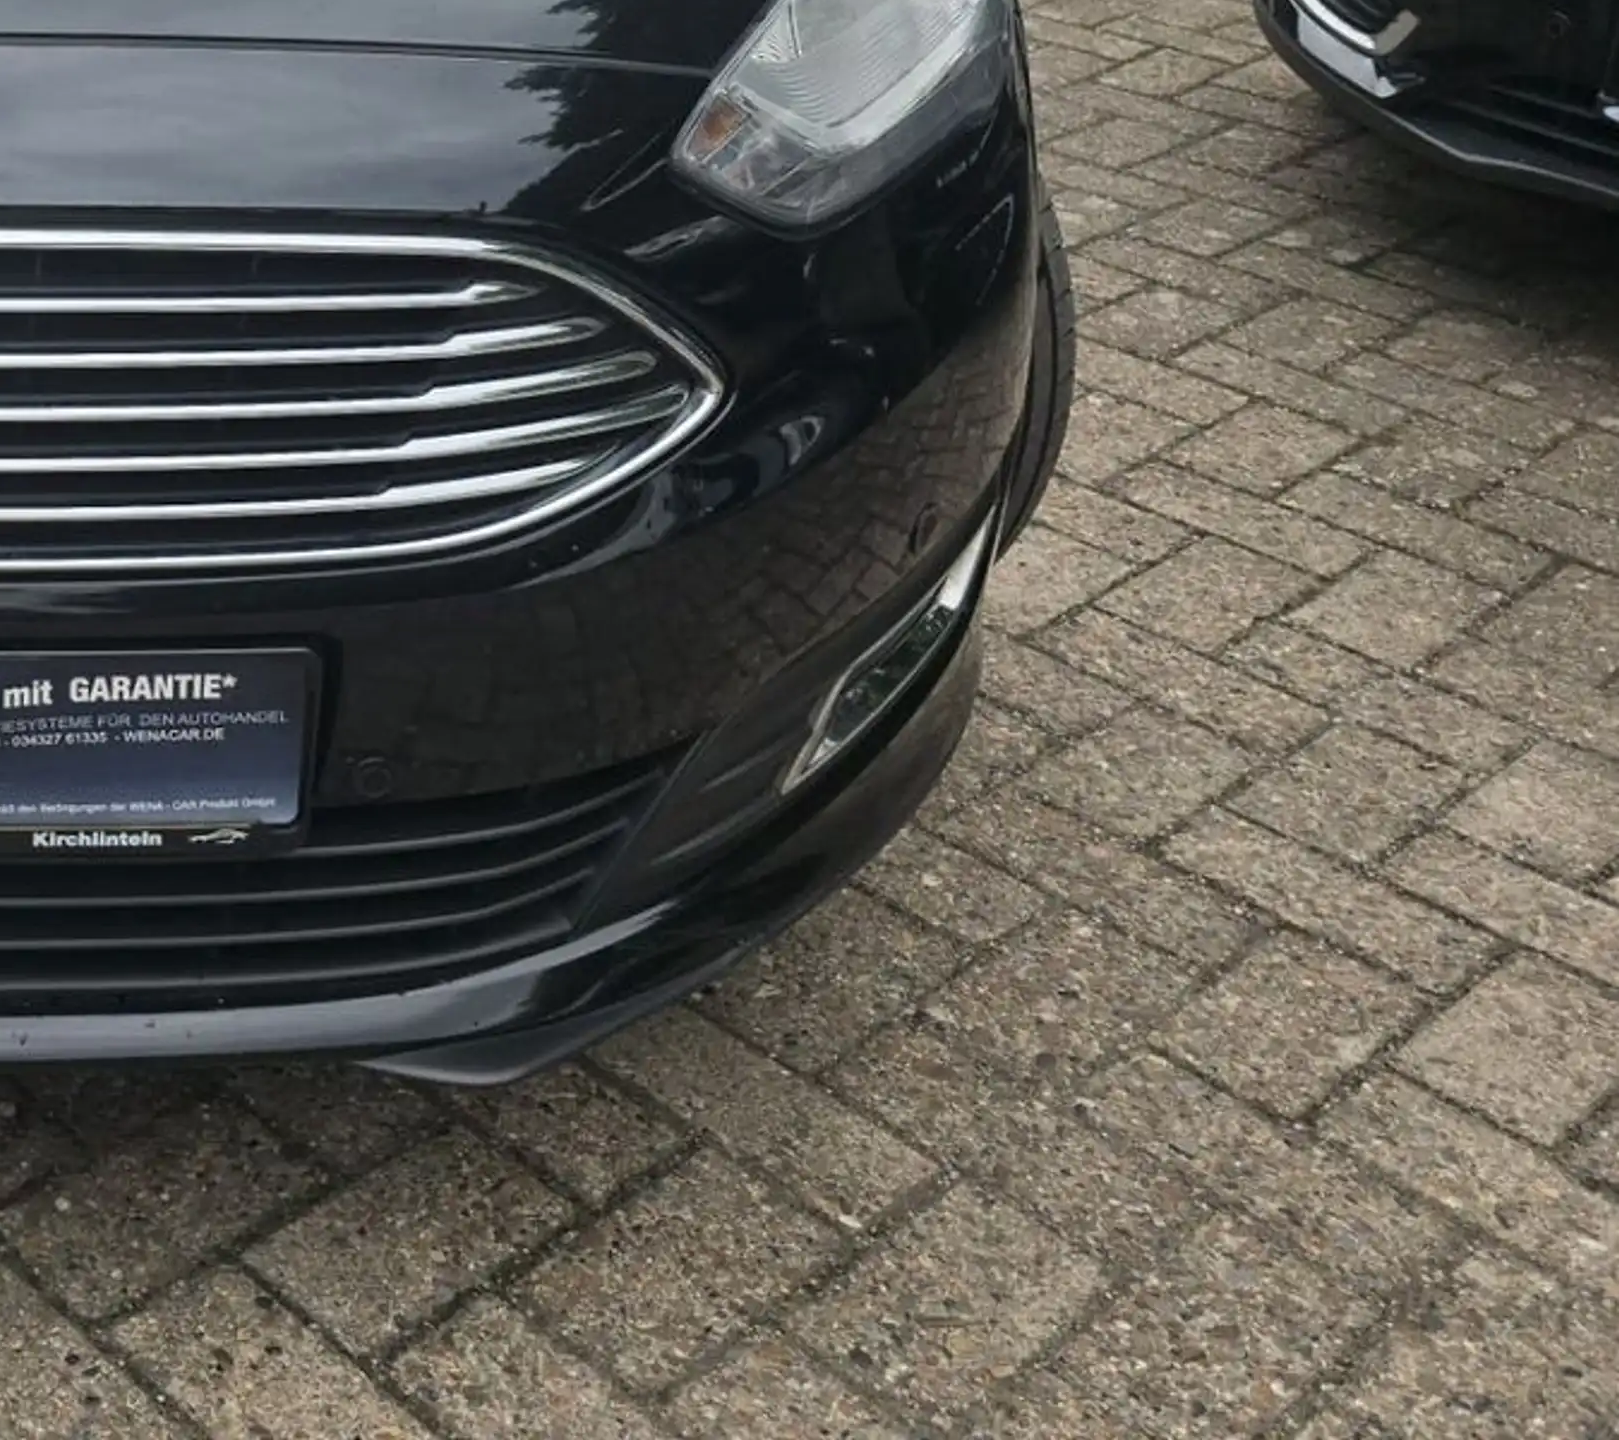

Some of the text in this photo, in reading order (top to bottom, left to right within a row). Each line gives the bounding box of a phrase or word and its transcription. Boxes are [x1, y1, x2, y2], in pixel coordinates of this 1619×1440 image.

[2, 678, 53, 709] mit
[138, 713, 173, 727] DEN
[177, 710, 289, 725] AUTOHANDEL
[122, 727, 225, 744] WENACAR.DE
